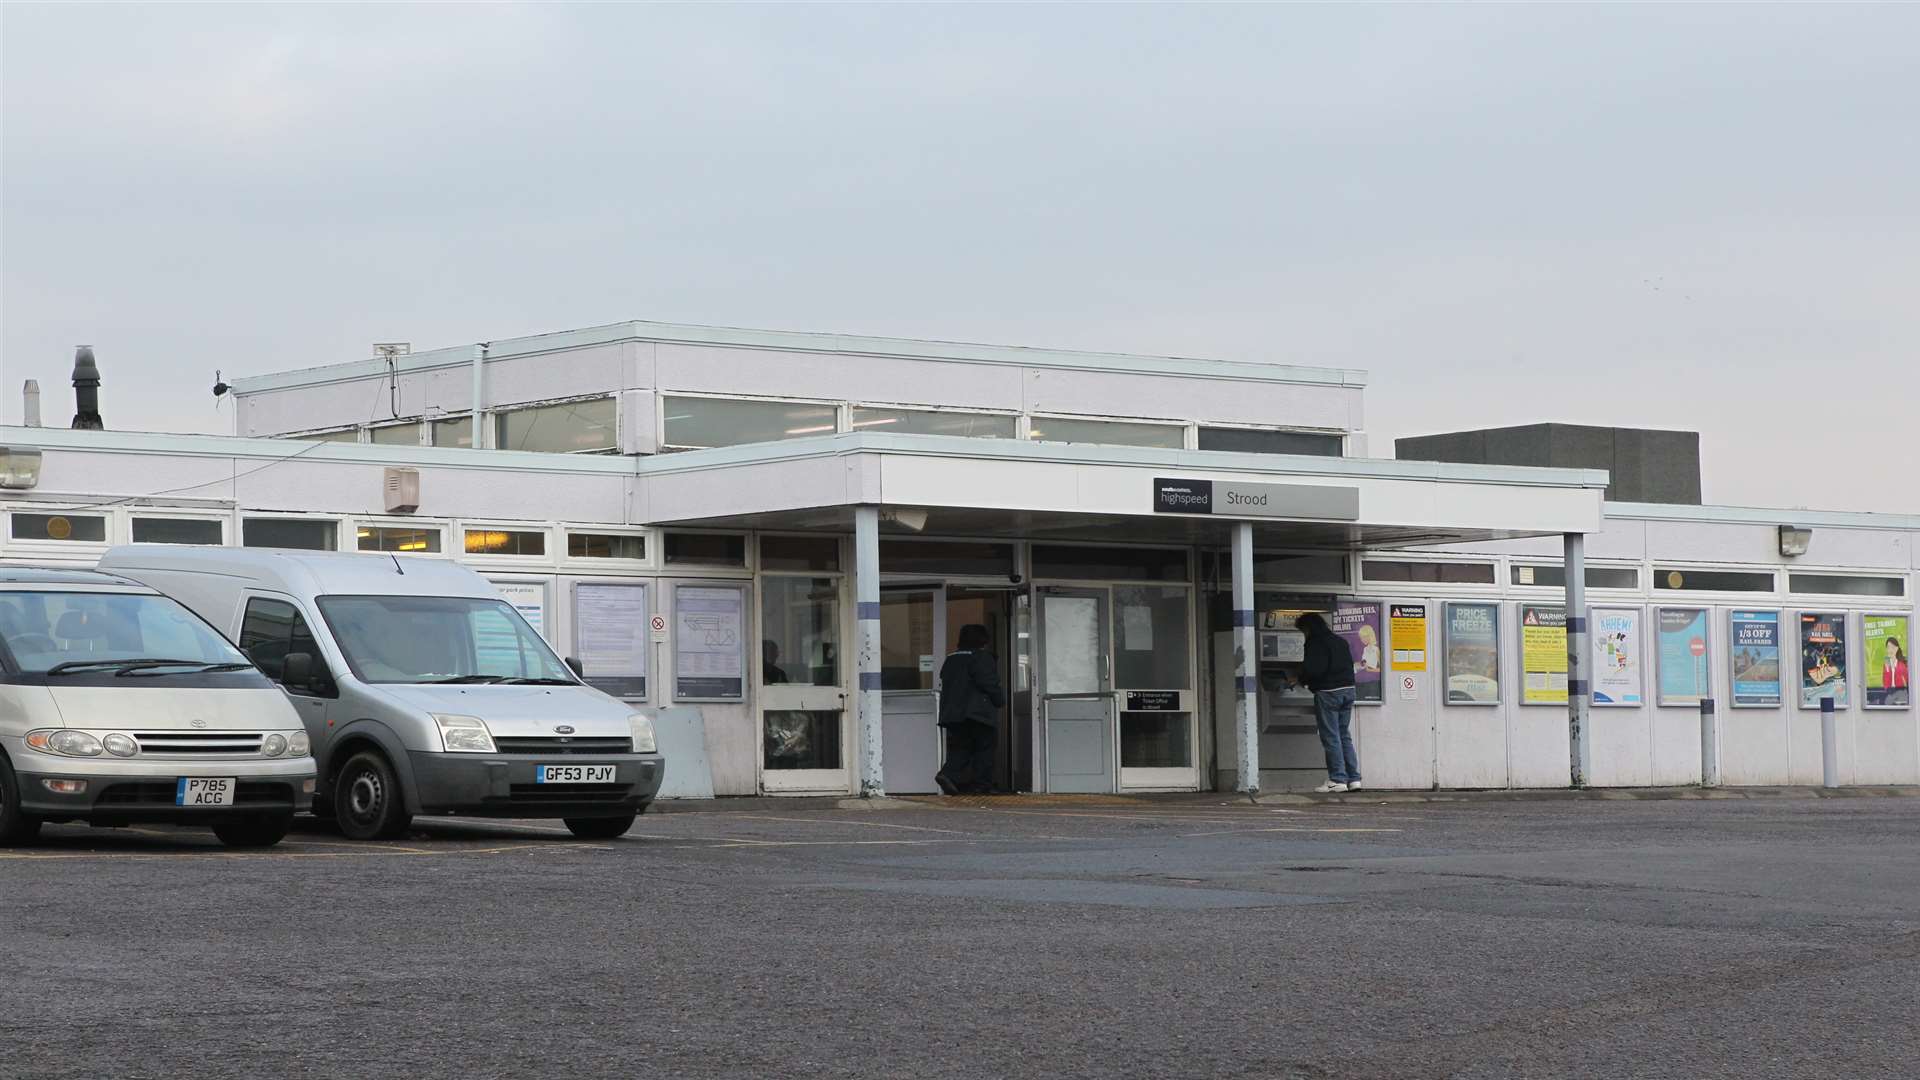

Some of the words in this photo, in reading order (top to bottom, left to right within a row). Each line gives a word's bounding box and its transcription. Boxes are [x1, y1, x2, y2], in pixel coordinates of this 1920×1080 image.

[1161, 492, 1208, 505] highspeed
[1227, 491, 1267, 505] Strood
[1456, 608, 1487, 619] PRICE
[1452, 620, 1492, 632] FREEZE
[1739, 629, 1752, 639] 1/3
[1752, 629, 1772, 638] OFF
[546, 767, 582, 781] GF53
[586, 767, 612, 780] PJY
[189, 780, 227, 791] P785
[194, 792, 222, 804] ACG
